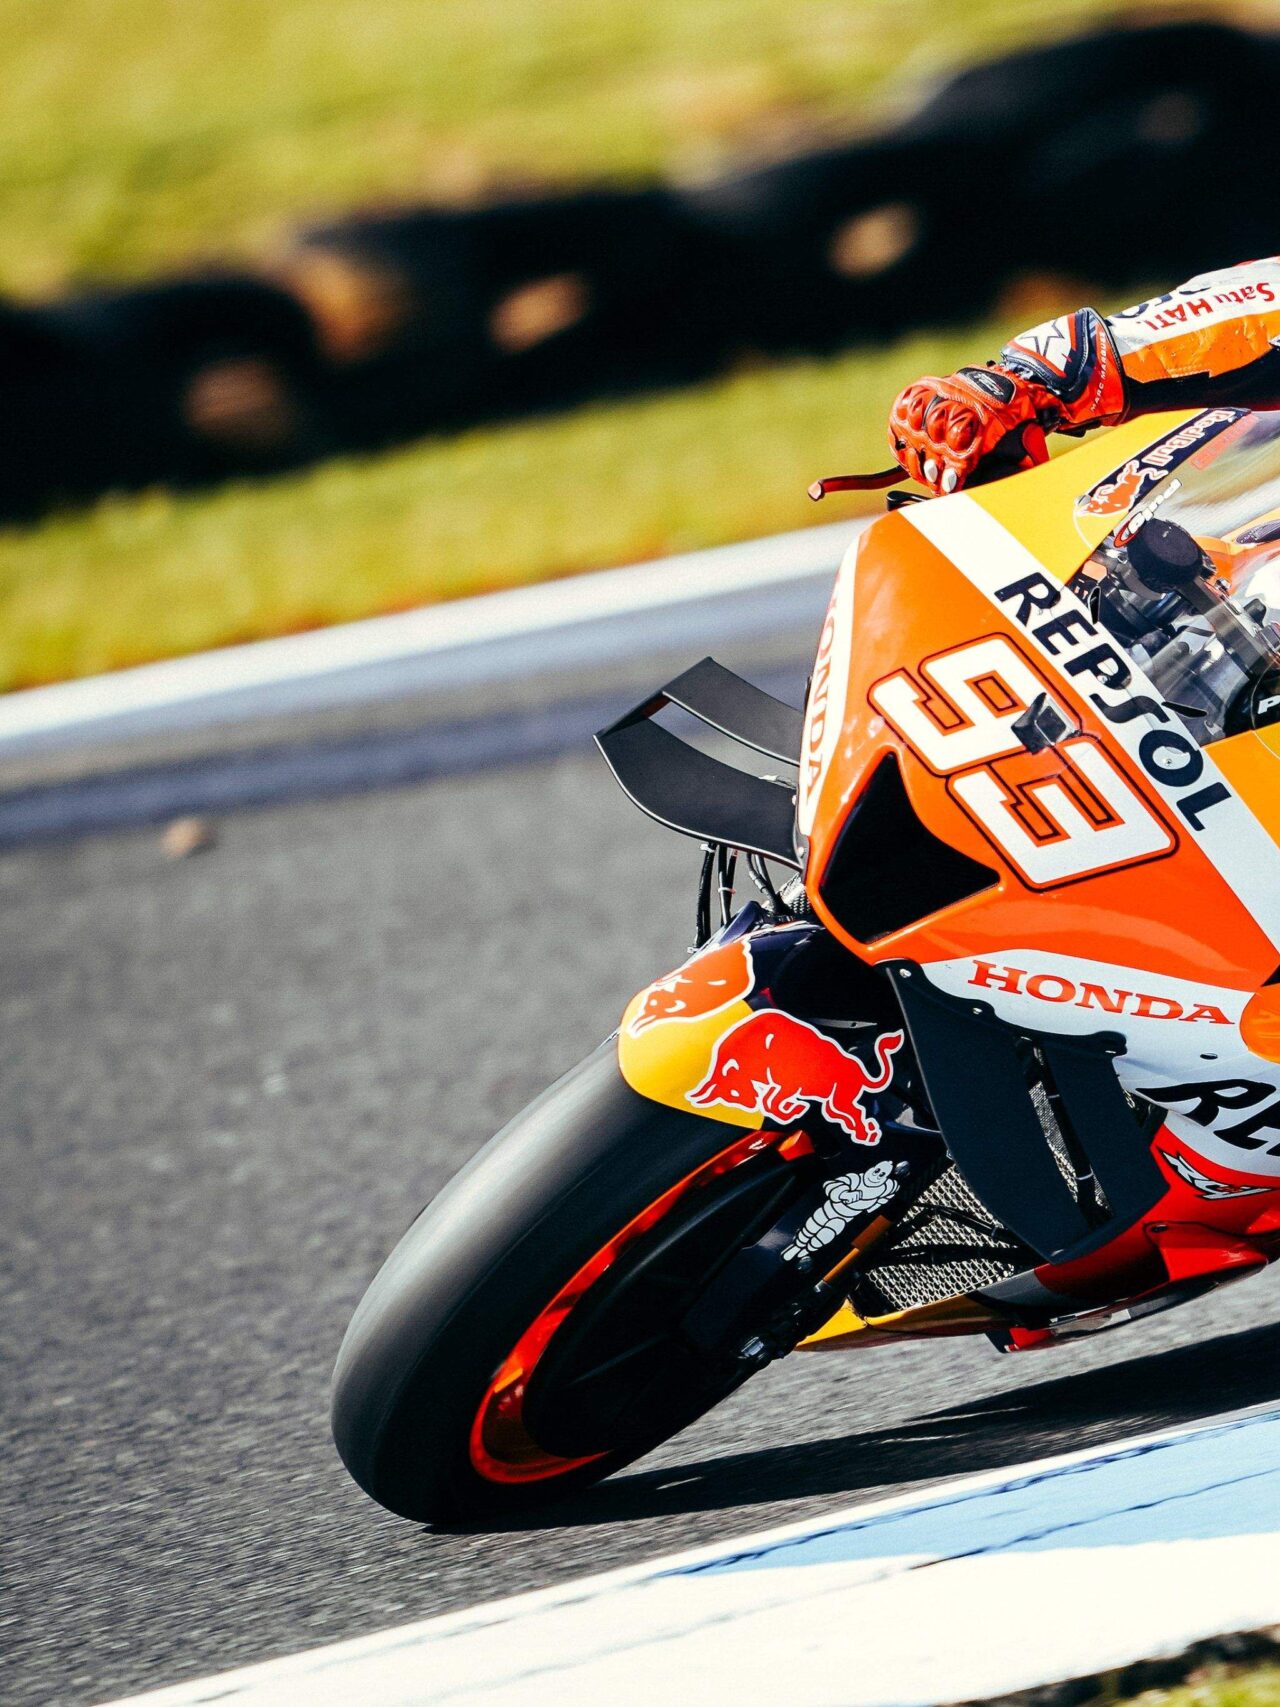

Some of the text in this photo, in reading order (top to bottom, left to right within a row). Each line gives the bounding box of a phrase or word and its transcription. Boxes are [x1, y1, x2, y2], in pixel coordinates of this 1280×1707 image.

[1213, 281, 1276, 304] Satu
[868, 632, 1180, 893] 93
[994, 570, 1233, 833] REPSOL
[967, 959, 1239, 1027] HONDA
